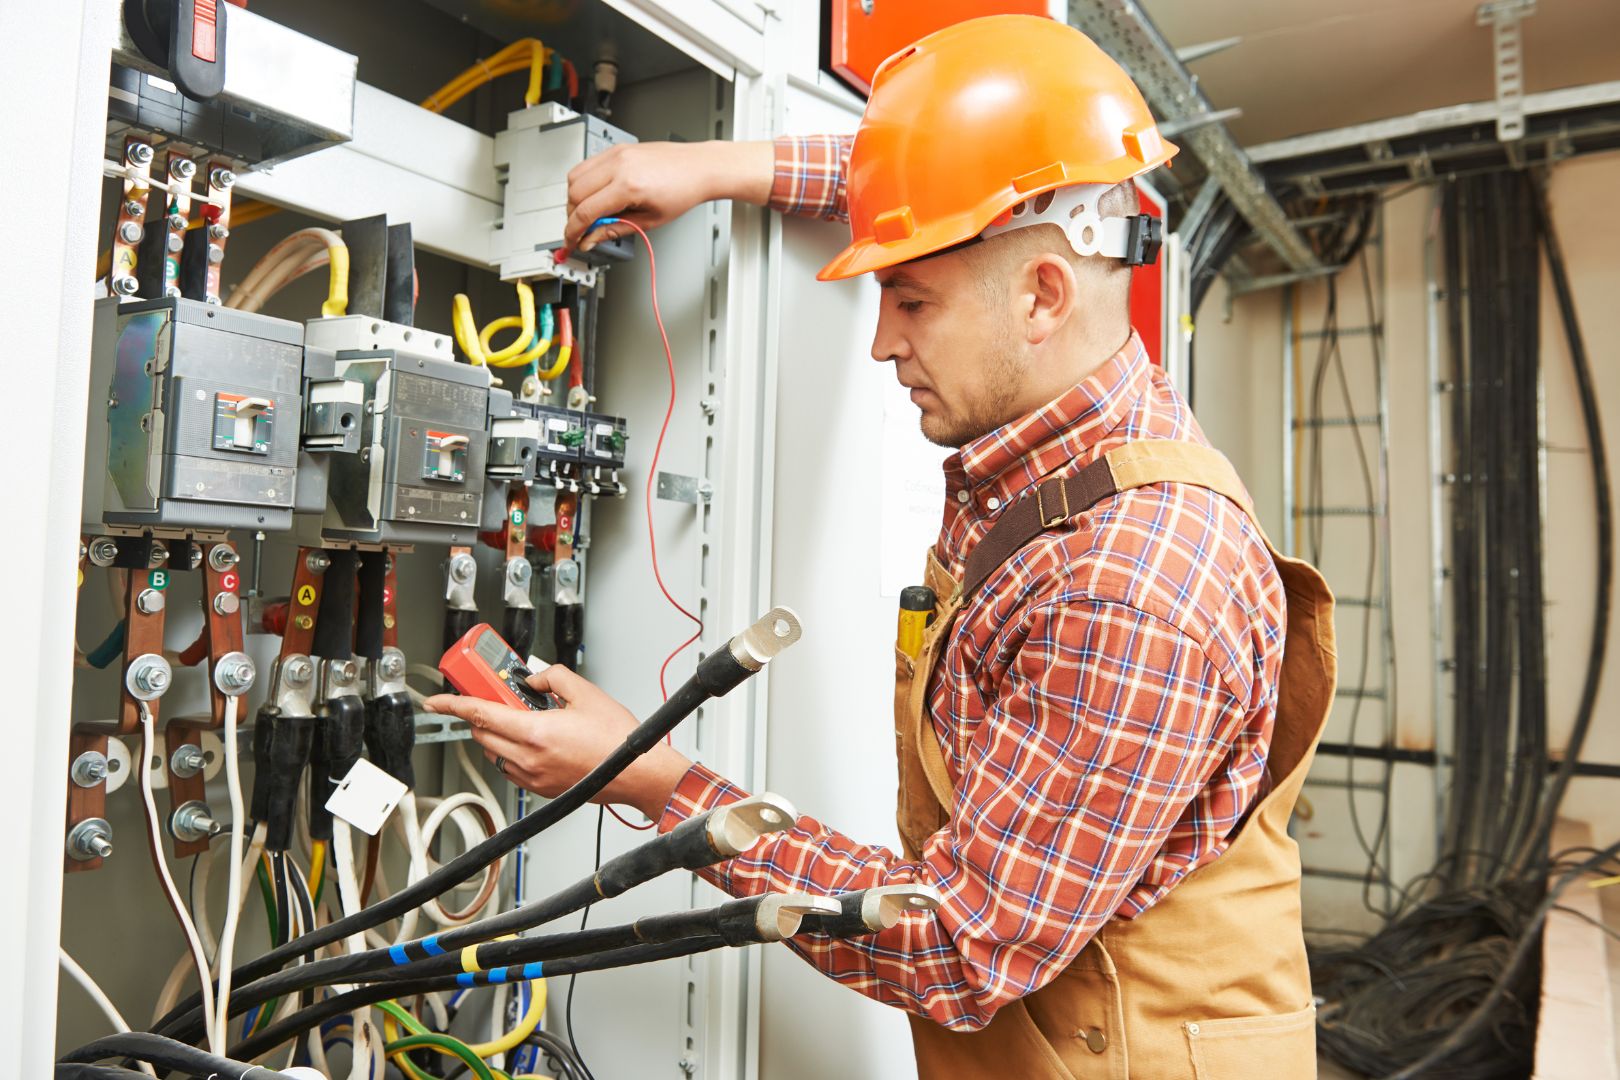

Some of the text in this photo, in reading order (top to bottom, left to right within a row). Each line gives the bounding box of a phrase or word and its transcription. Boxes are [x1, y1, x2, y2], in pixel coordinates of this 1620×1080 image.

[514, 511, 523, 523] B
[560, 516, 569, 529] C
[152, 571, 166, 587] B
[223, 574, 235, 589] C
[302, 588, 312, 601] A
